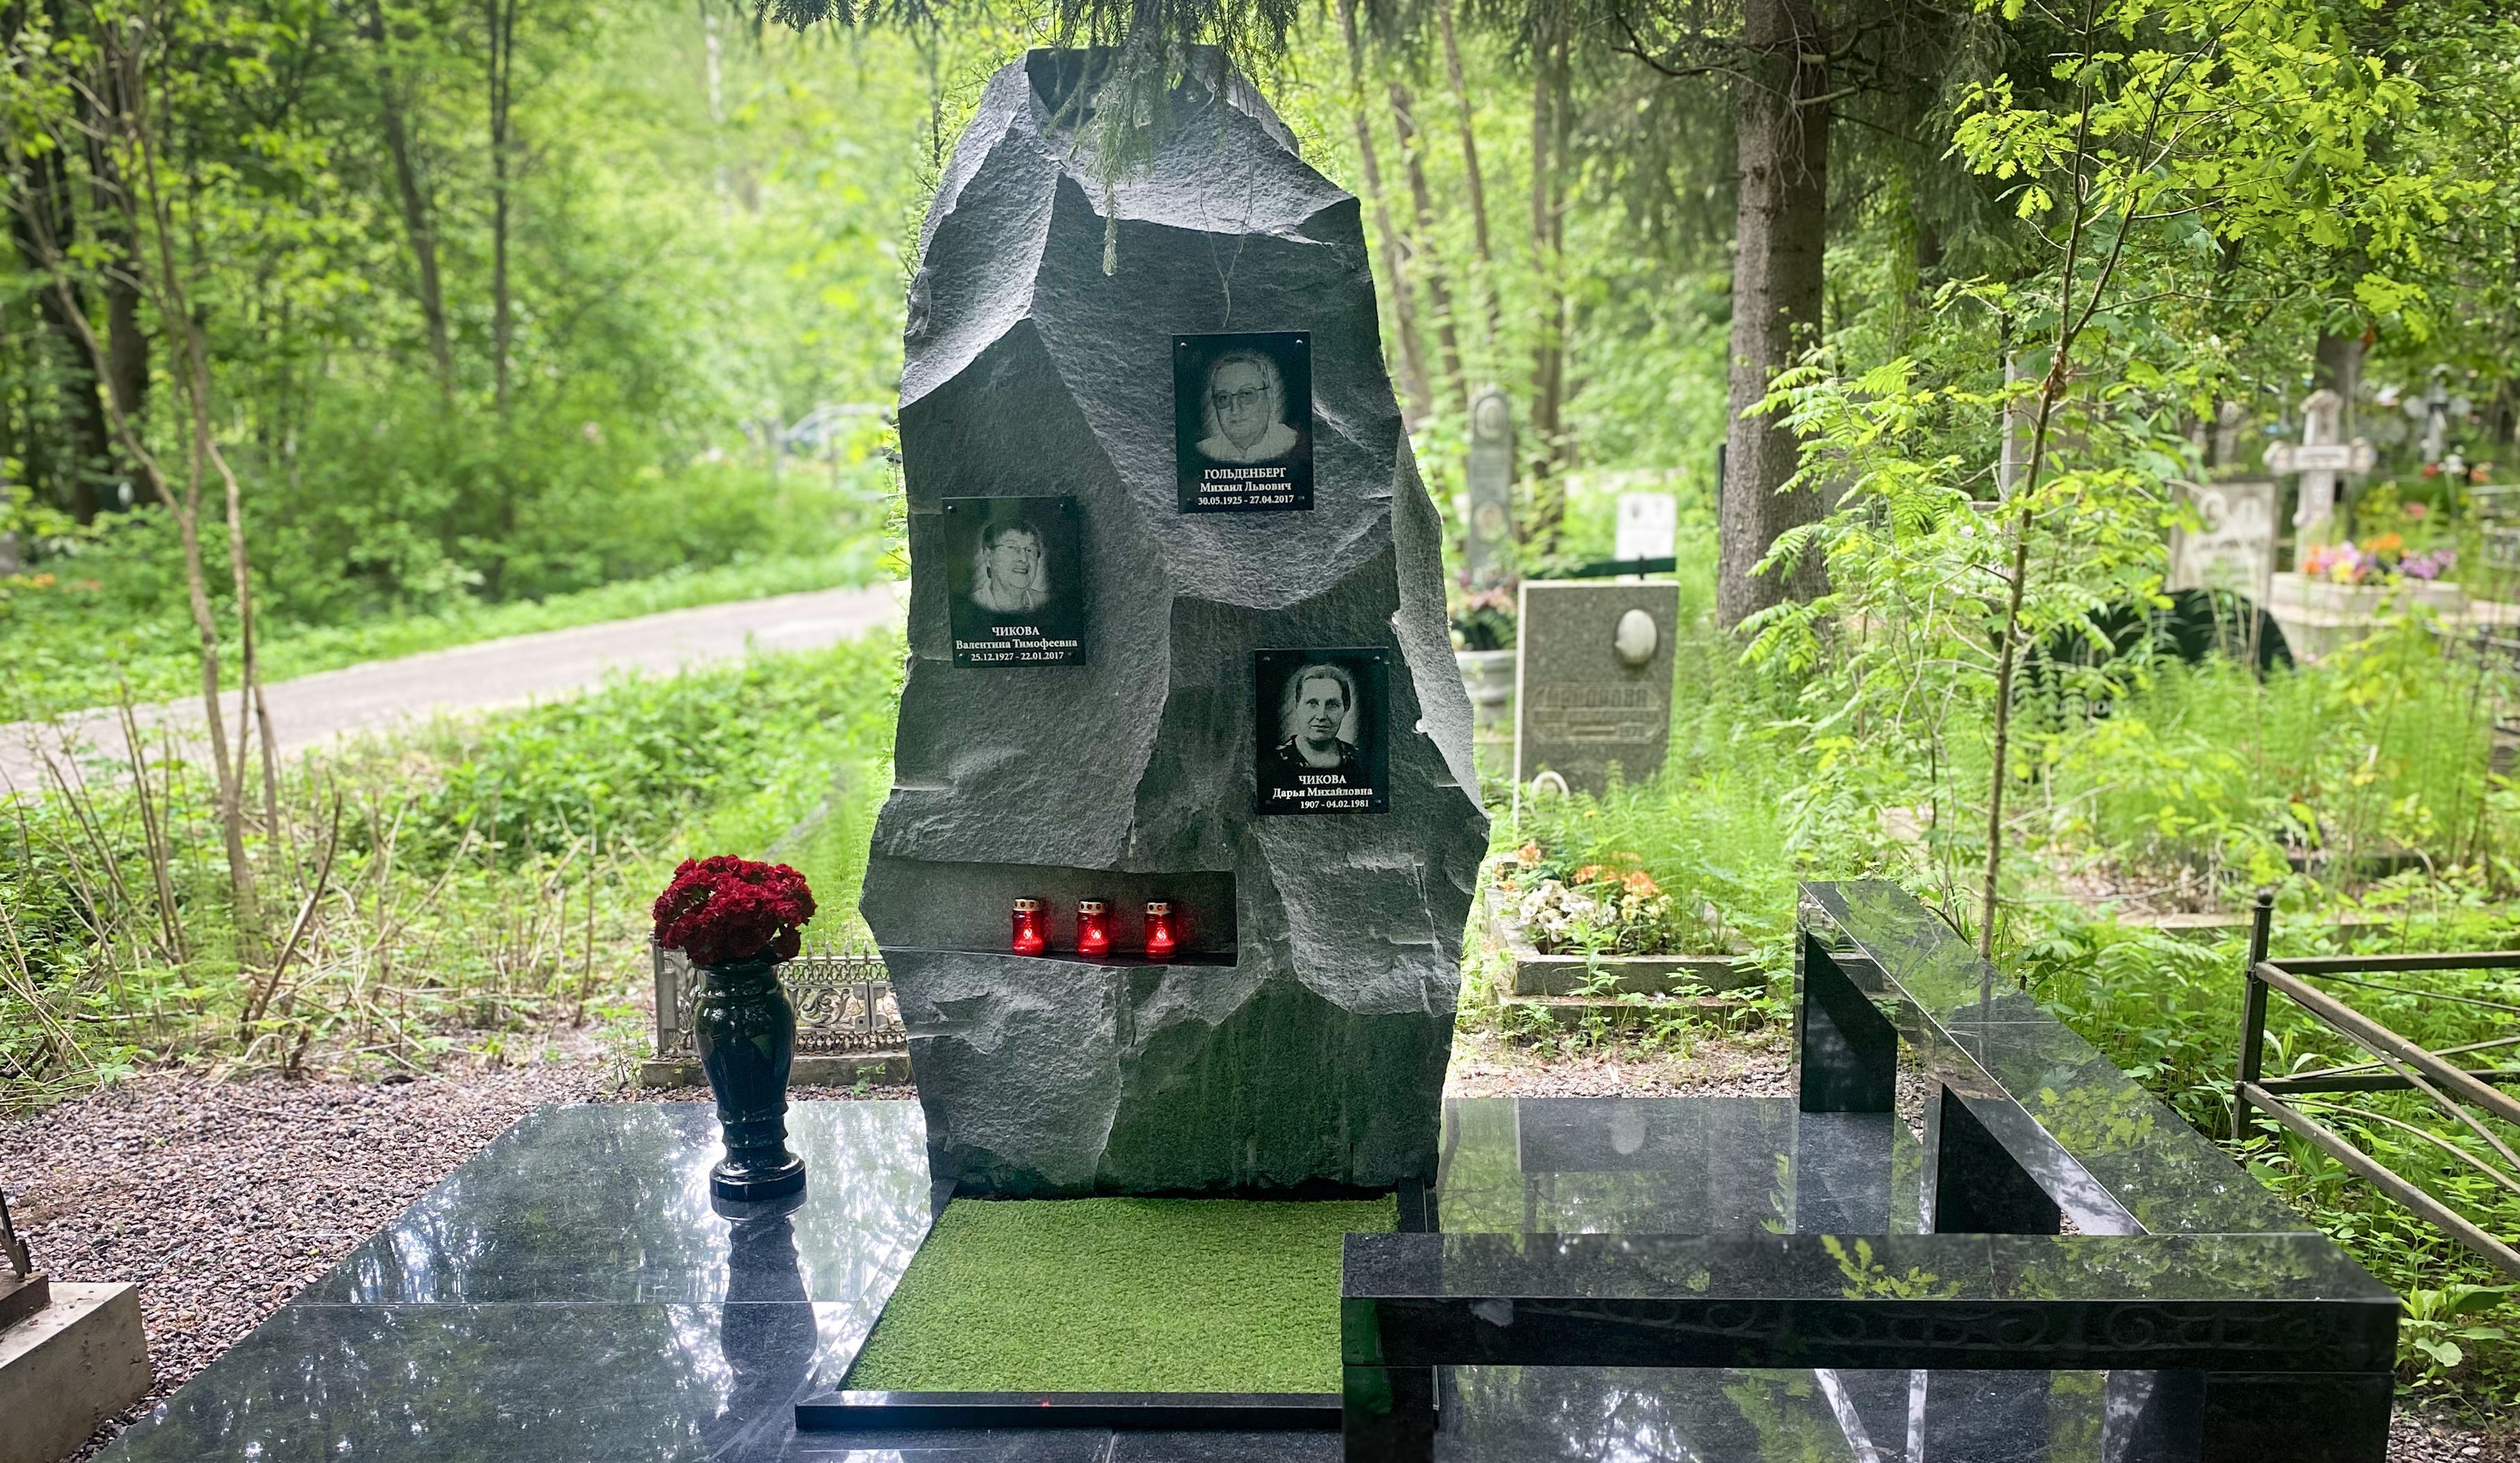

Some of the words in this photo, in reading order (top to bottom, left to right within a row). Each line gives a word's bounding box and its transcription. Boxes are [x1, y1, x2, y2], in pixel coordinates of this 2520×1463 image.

[1204, 468, 1286, 480] ГОЛЬДЕНБЕРГ
[1200, 482, 1243, 493] Михаил
[1244, 481, 1292, 492] Львович
[1198, 496, 1243, 506] 30.05.1925
[1249, 495, 1295, 504] 27.04.2017
[991, 626, 1040, 636] ЧИКОВА
[955, 640, 1011, 650] Валентина
[1012, 638, 1078, 650] Тимофеевна
[971, 652, 1014, 661] 25.12.1927
[1020, 651, 1064, 660] 22.01.2017
[1298, 774, 1347, 785] ЧИКОВА
[1272, 788, 1306, 800] Дарья
[1307, 787, 1373, 796] Михайловна
[1300, 801, 1320, 809] 1907
[1326, 799, 1369, 808] 04.02.1981
